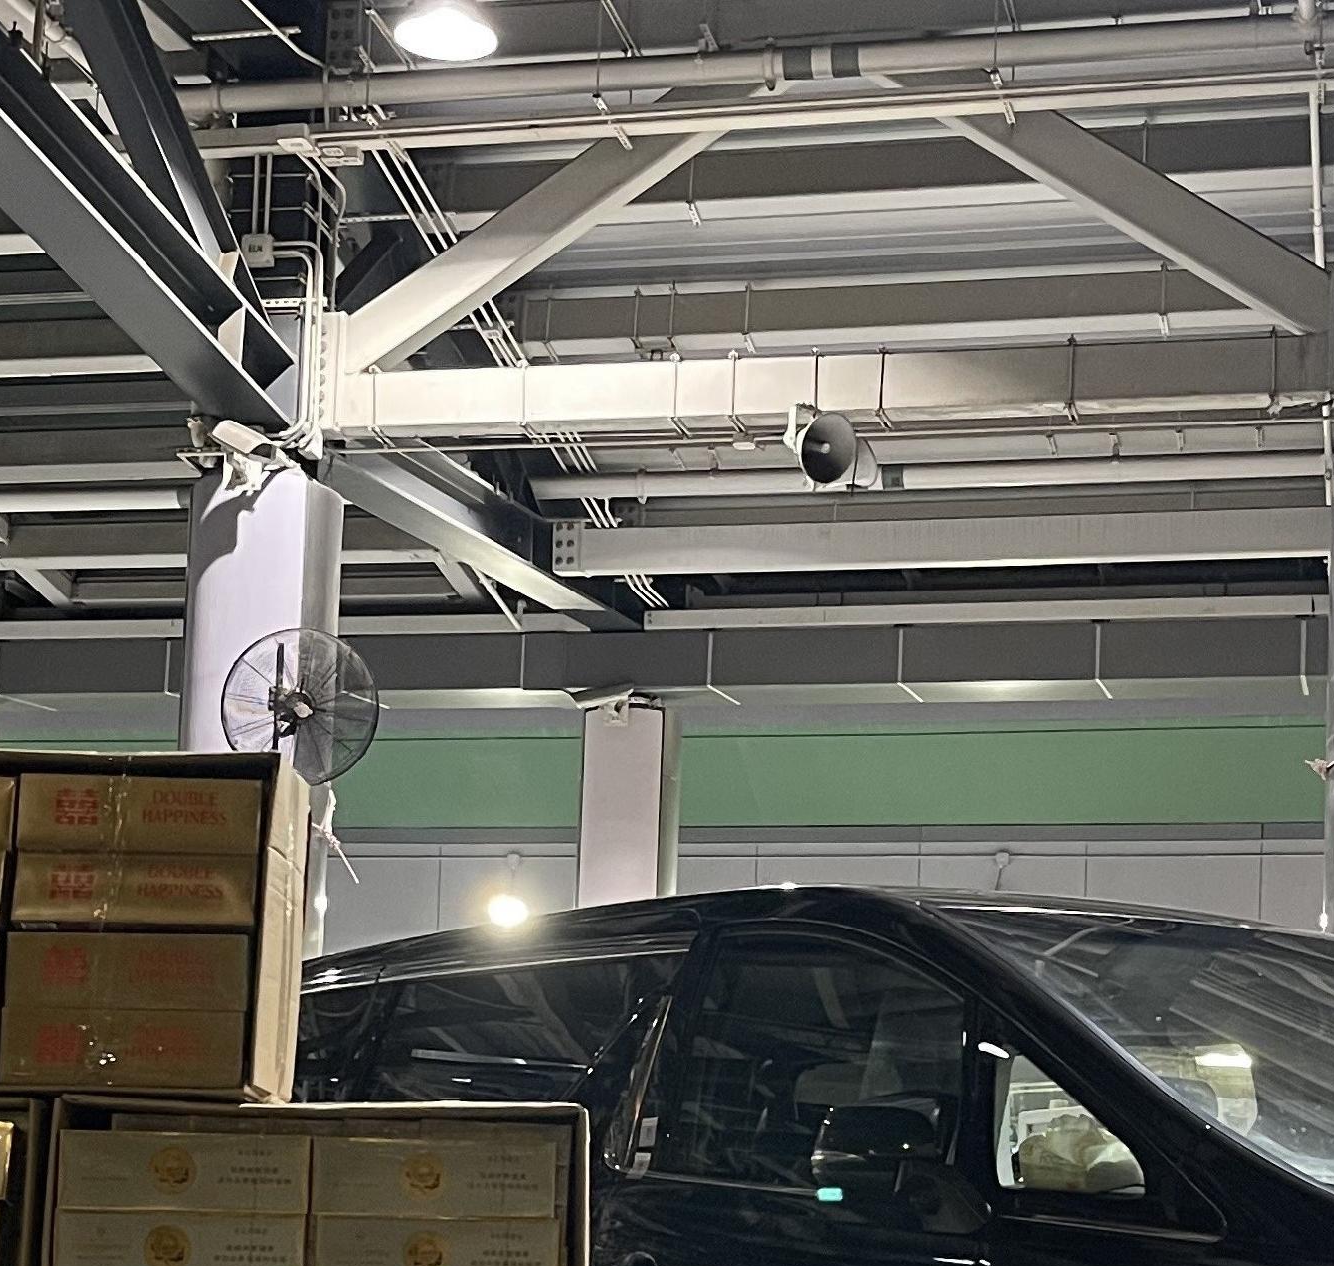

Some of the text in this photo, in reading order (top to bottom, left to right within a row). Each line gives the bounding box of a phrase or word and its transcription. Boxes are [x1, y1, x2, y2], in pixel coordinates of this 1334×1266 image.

[153, 789, 220, 807] DOUBLE
[142, 808, 228, 825] HAPPINESS
[137, 883, 225, 898] HAPPINESS
